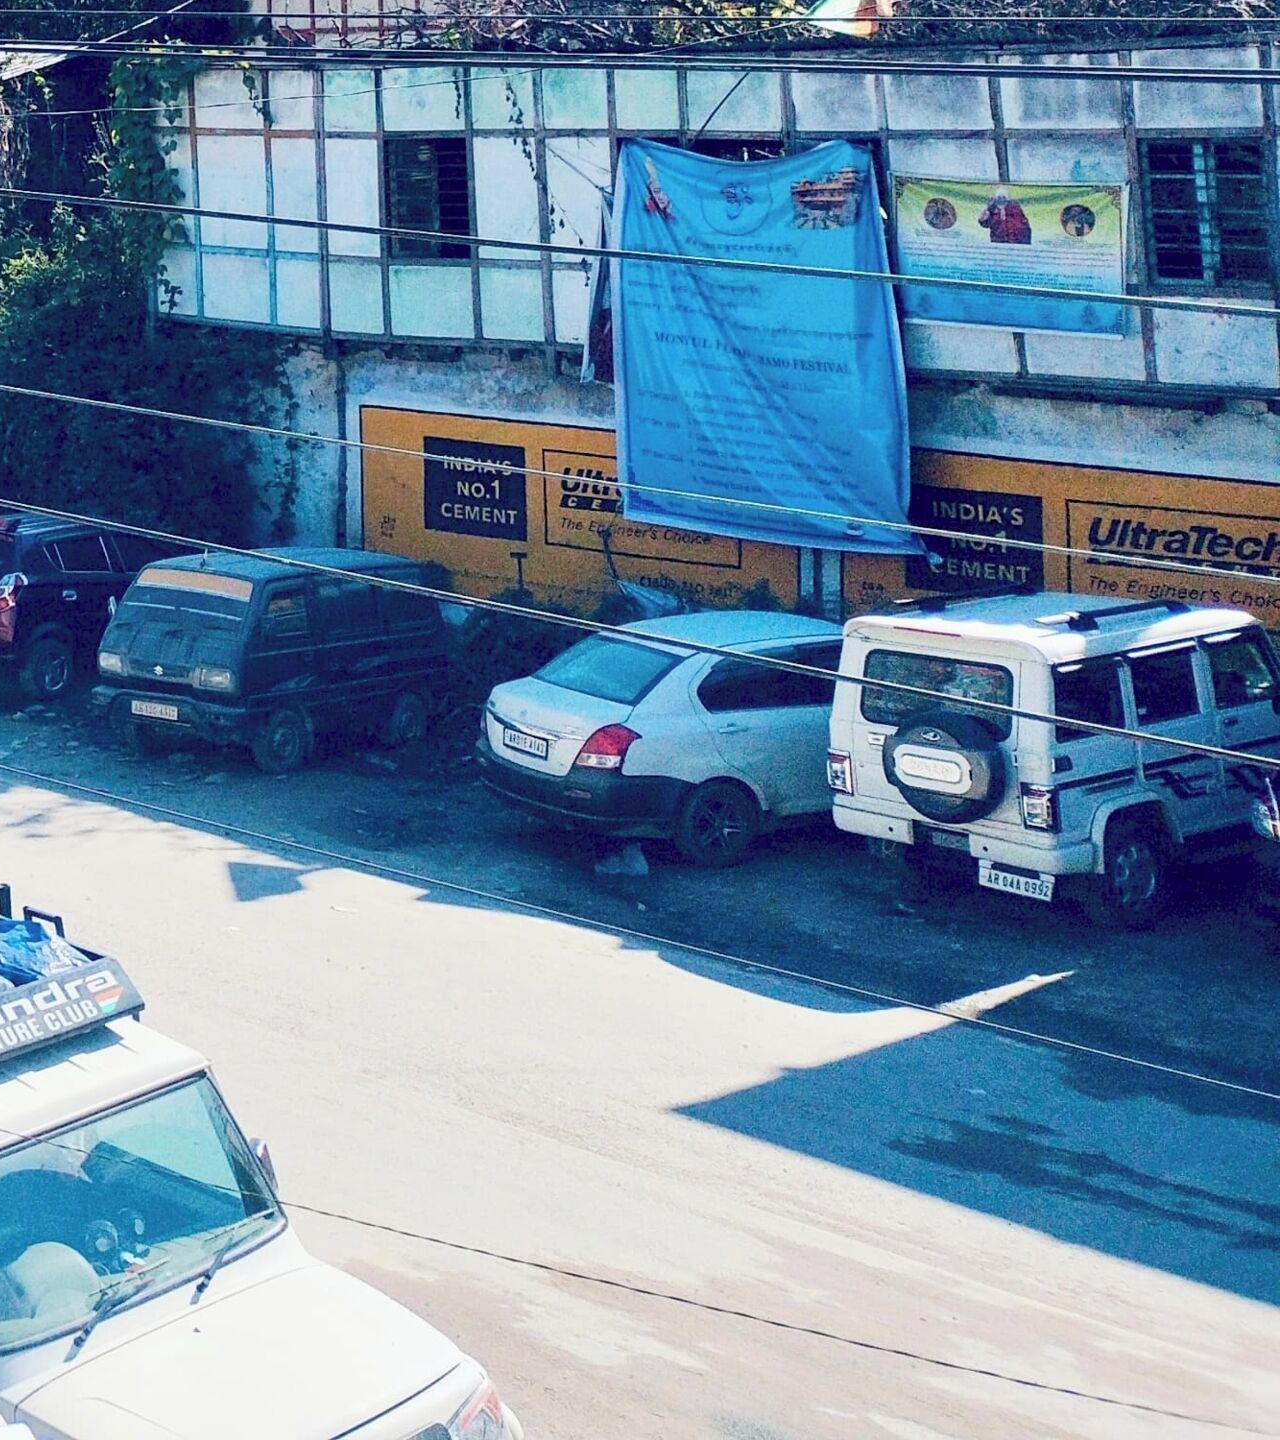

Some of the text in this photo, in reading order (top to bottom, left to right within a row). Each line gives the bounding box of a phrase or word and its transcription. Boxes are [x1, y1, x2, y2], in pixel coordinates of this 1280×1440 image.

[792, 359, 852, 375] FESTIVAL
[443, 454, 514, 476] INDIA'S
[456, 479, 500, 500] NO.1
[441, 502, 518, 525] CEMENT
[561, 517, 583, 531] The
[932, 501, 1025, 527] INDIA'S
[1089, 575, 1119, 592] The
[1126, 580, 1221, 603] Engineer's
[44, 999, 99, 1033] CLUB
